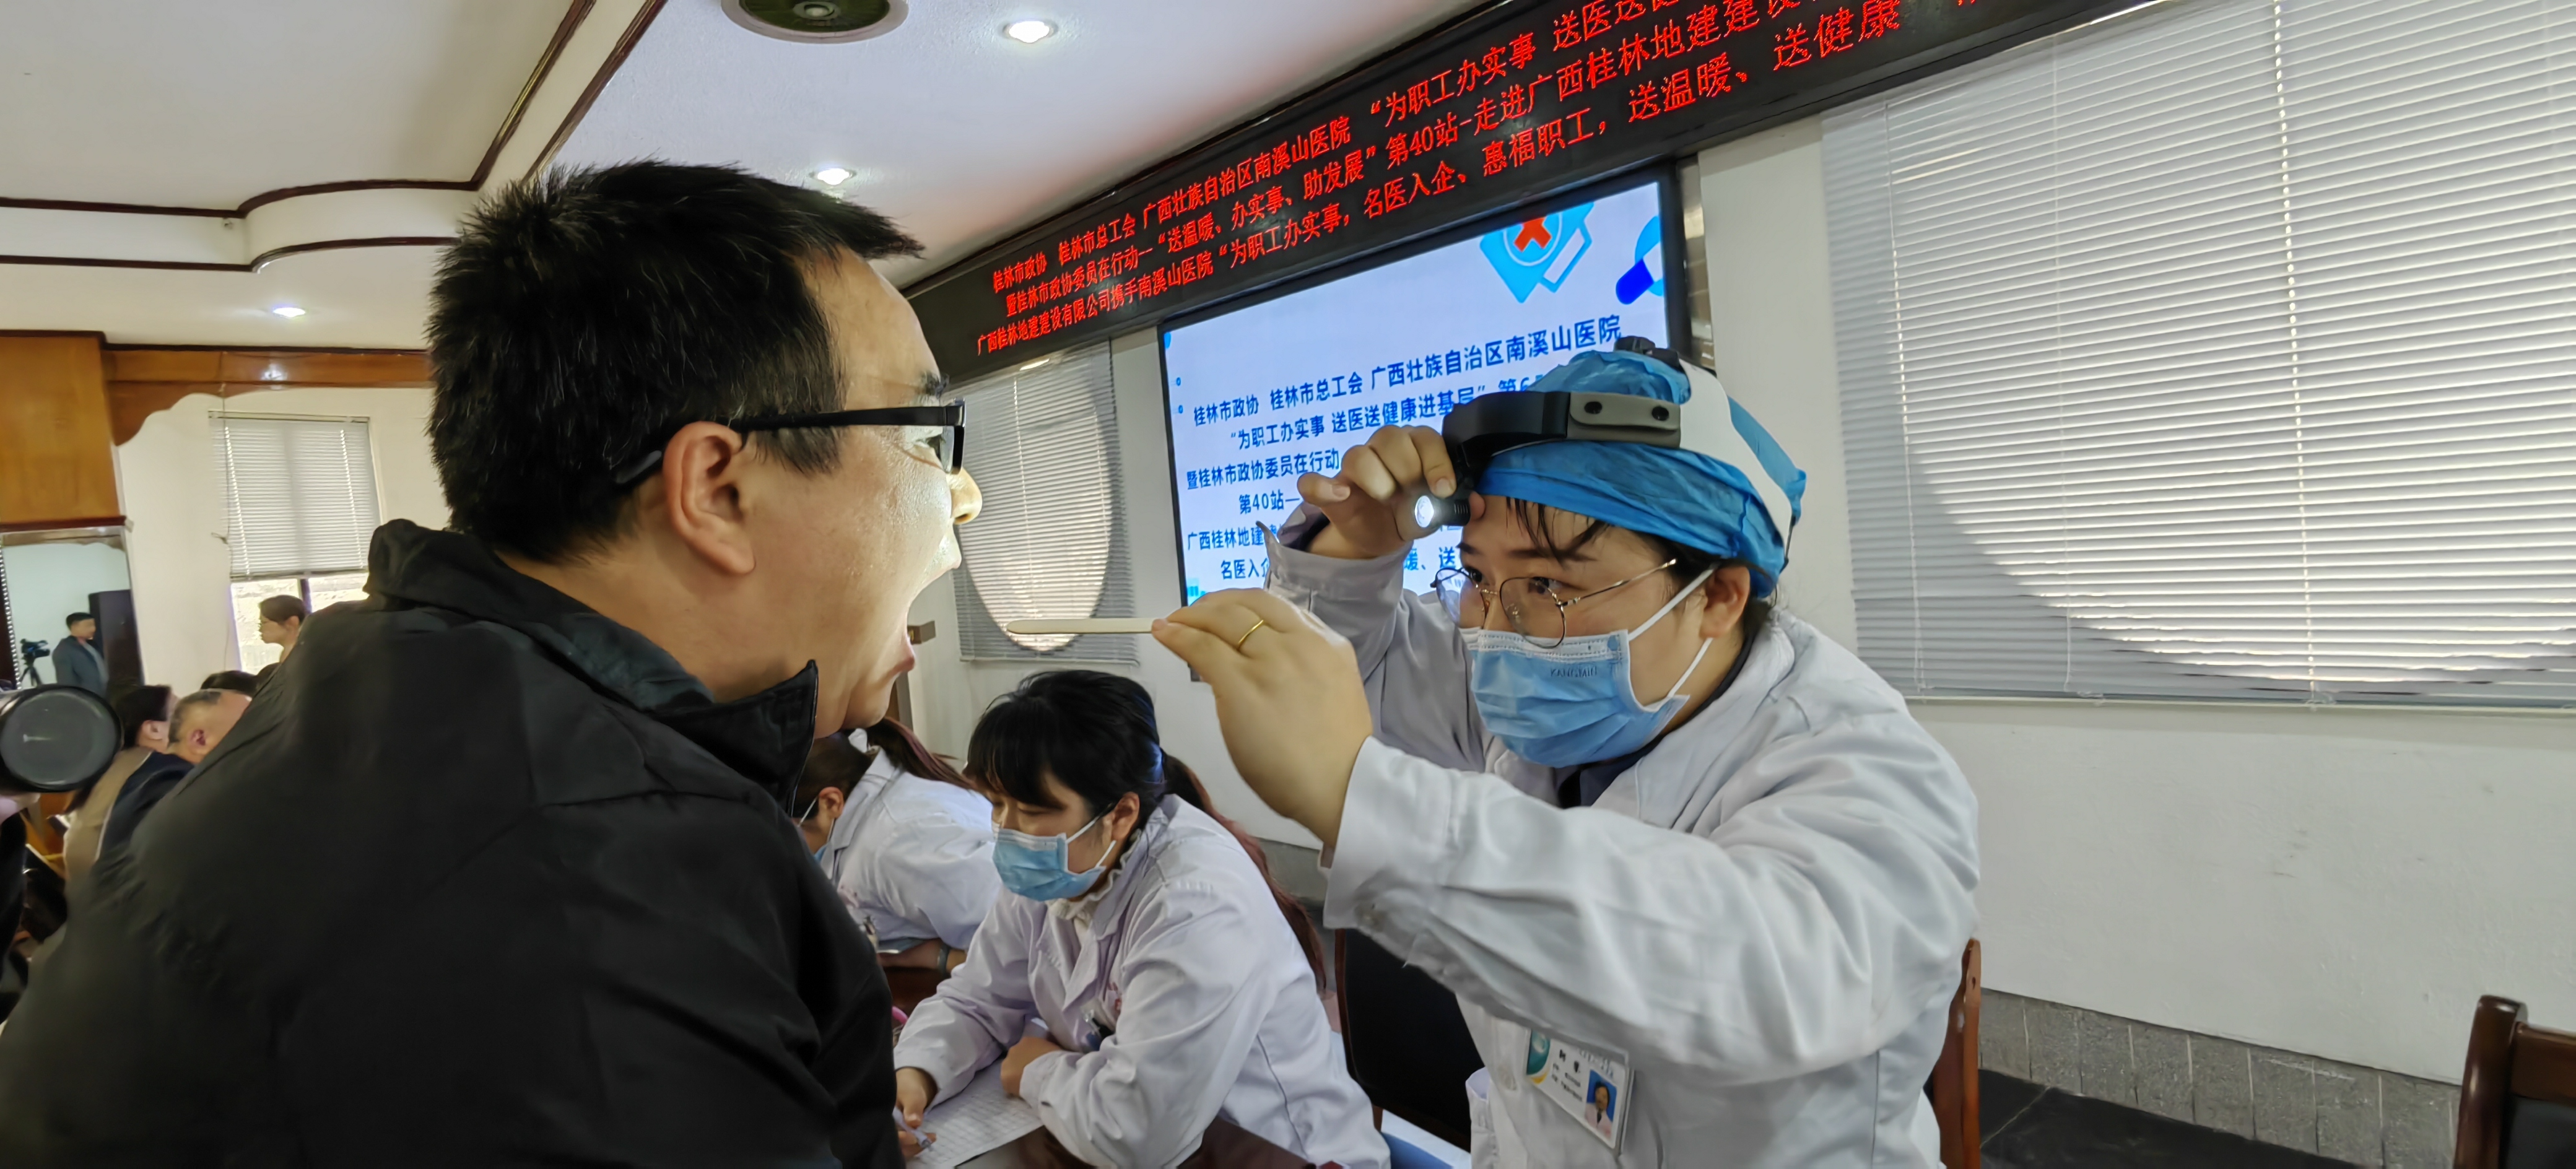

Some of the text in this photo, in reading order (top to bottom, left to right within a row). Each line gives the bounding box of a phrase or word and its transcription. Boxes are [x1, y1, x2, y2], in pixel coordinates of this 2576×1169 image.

[993, 0, 1679, 293] 桂林市政协 桂林市总工会 广西壮族自治区南溪山医院 “为职工办实事 送医送
[1193, 314, 1622, 427] 桂林市政协 桂林市总工会 广西壮族自治区南溪山医院
[1230, 415, 1325, 450] “为职工办实事
[1186, 448, 1339, 490] 暨桂林市政协委员在行动
[1188, 523, 1277, 550] 广西桂林地建
